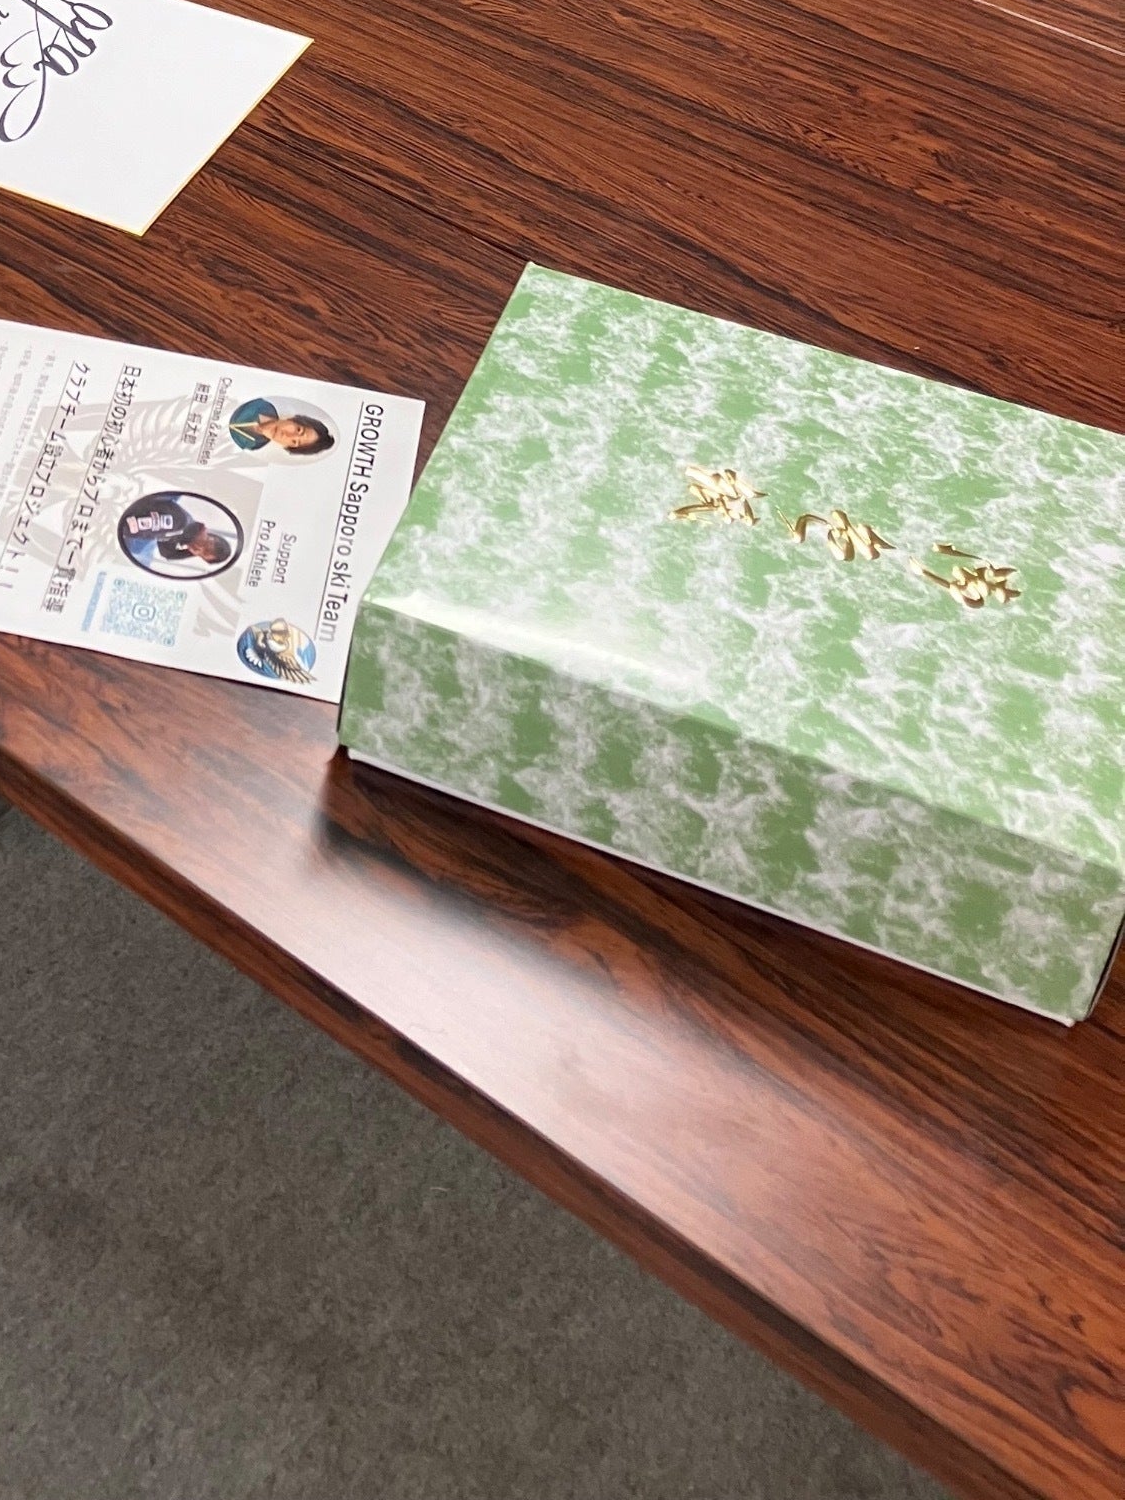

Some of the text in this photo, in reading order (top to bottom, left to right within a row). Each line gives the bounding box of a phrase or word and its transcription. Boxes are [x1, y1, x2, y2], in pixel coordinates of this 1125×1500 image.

[39, 364, 142, 614] 日本初の初心者からプロまで一貫指導
[247, 520, 275, 588] Pro Athlete
[271, 532, 297, 584] Support
[317, 403, 384, 643] GROWTH Sapporo ski Team
